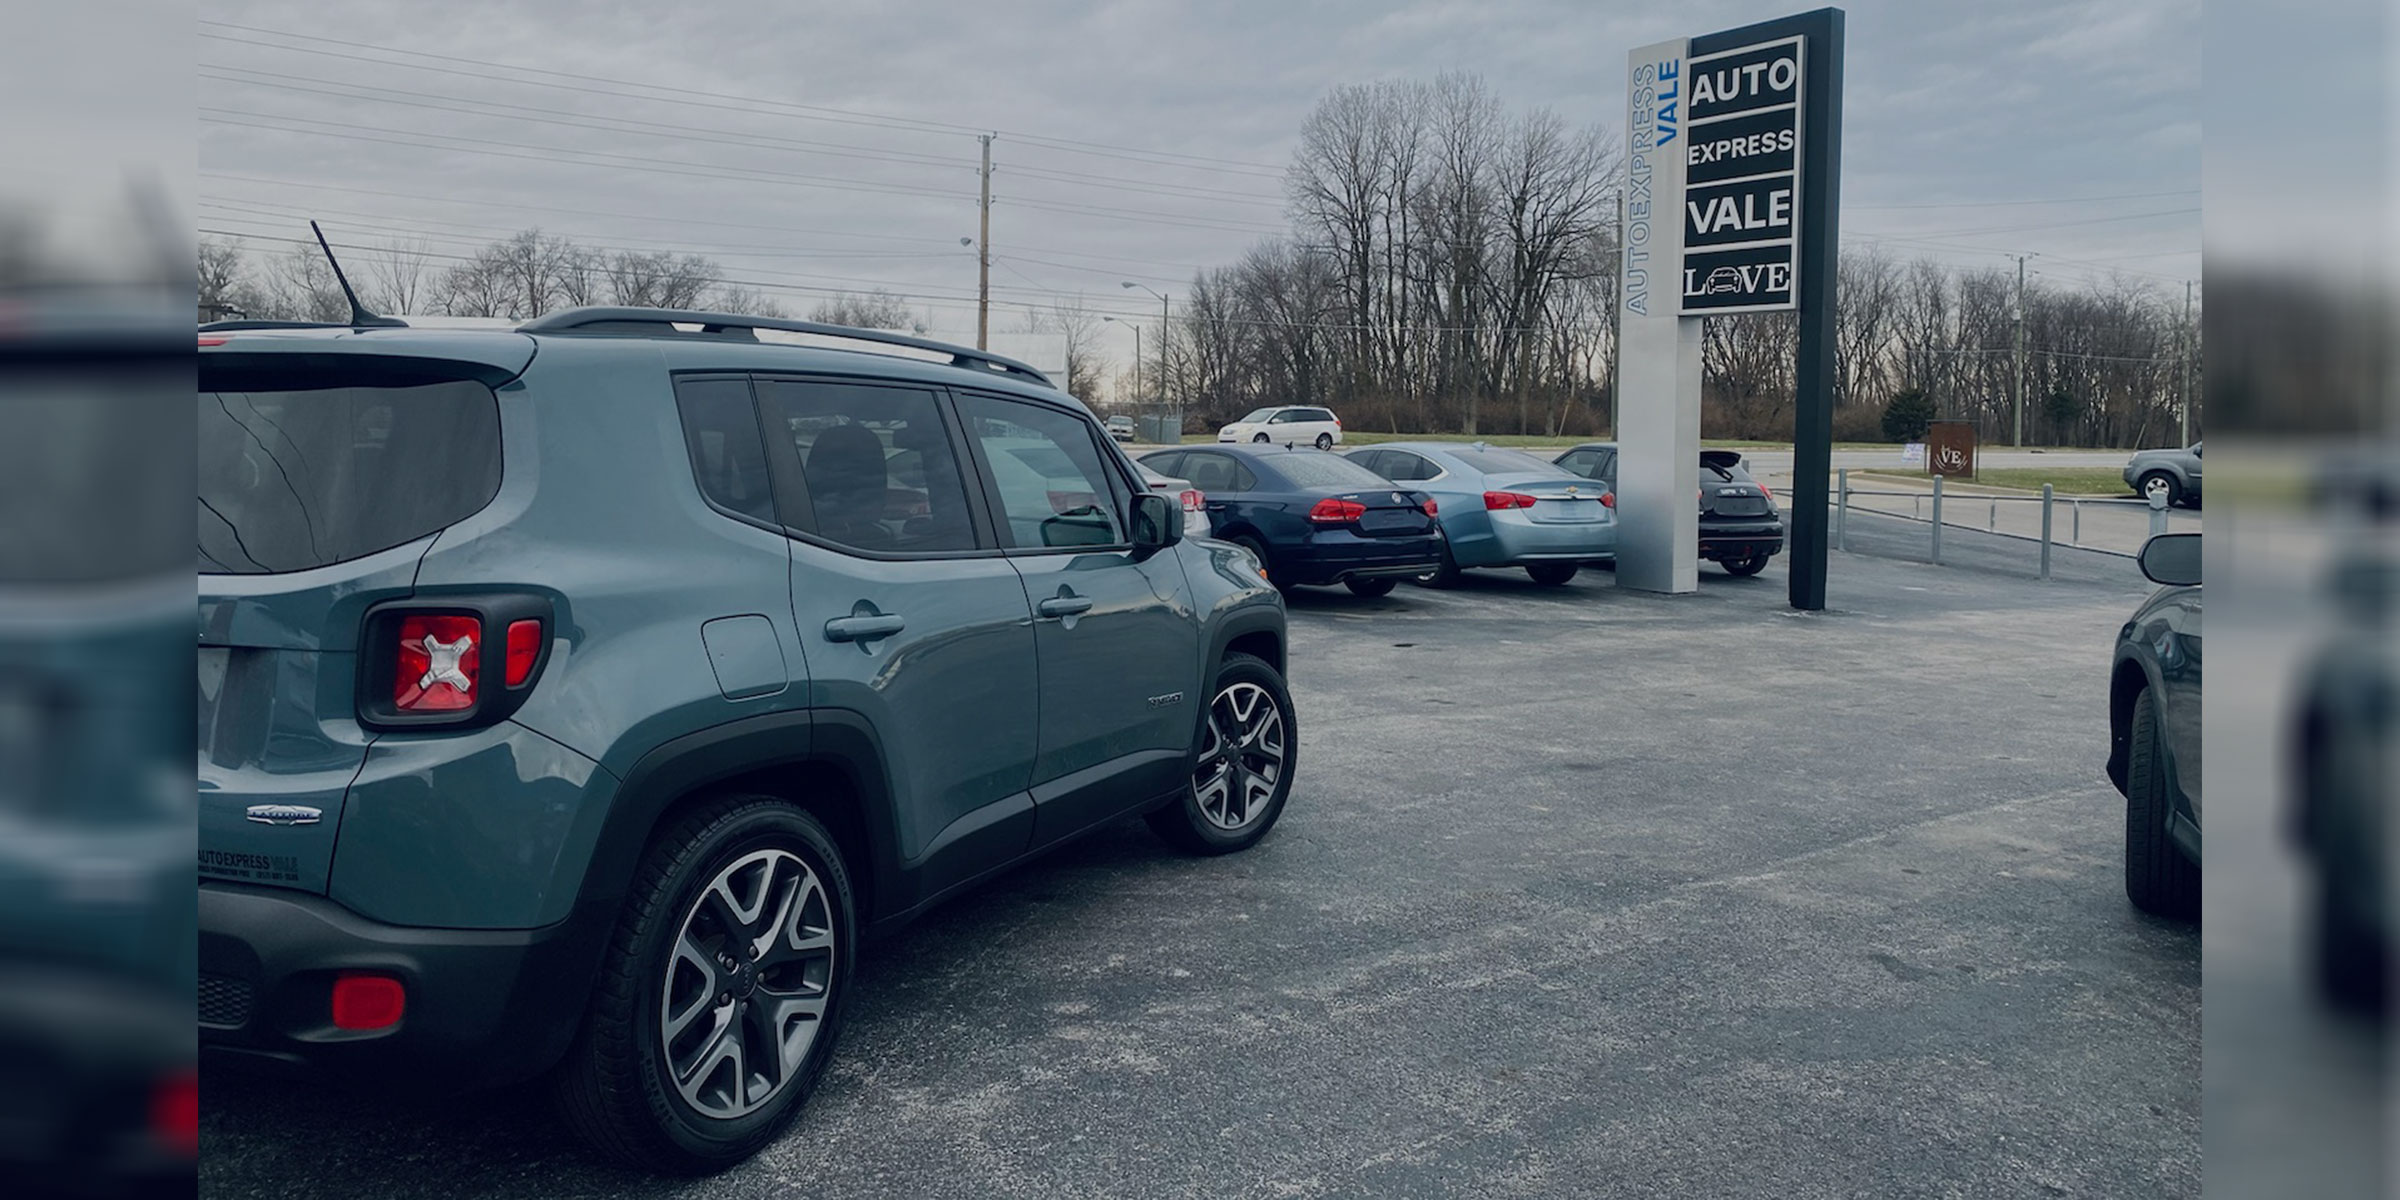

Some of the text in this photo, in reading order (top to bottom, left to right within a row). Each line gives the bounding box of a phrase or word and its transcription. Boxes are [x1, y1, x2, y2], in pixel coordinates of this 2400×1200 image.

[1656, 58, 1680, 147] VALE
[1690, 57, 1797, 107] AUTO
[1688, 129, 1794, 166] EXPRESS
[1626, 63, 1656, 317] AUTOEXPRESS
[1687, 189, 1791, 235] VALE
